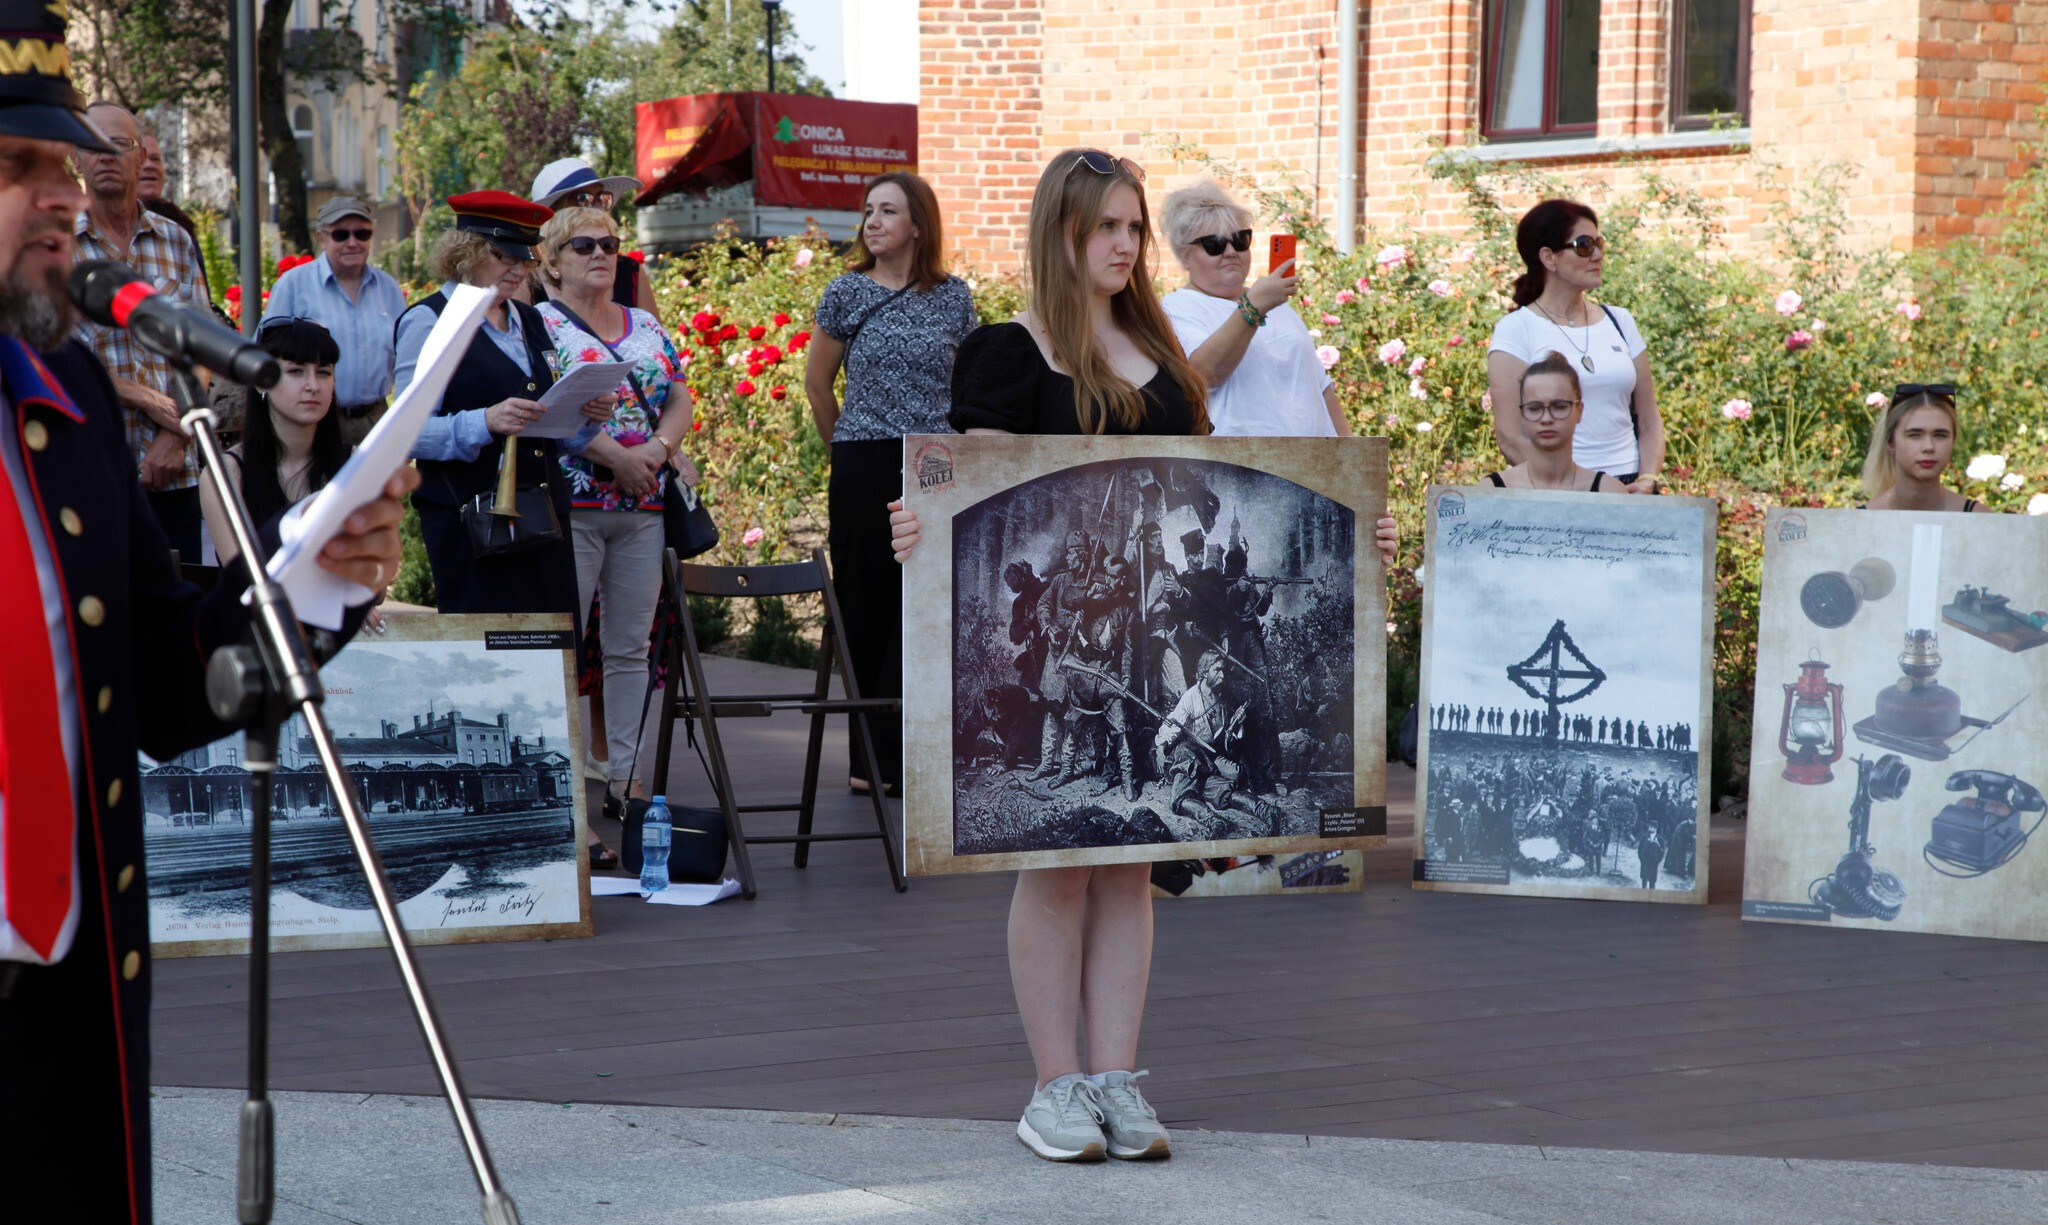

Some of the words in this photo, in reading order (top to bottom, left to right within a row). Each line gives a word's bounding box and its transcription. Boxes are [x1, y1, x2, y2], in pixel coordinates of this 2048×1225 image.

[920, 470, 953, 489] KOLEJ
[1438, 507, 1465, 518] KOLEJ
[1778, 530, 1807, 543] KOLEJ
